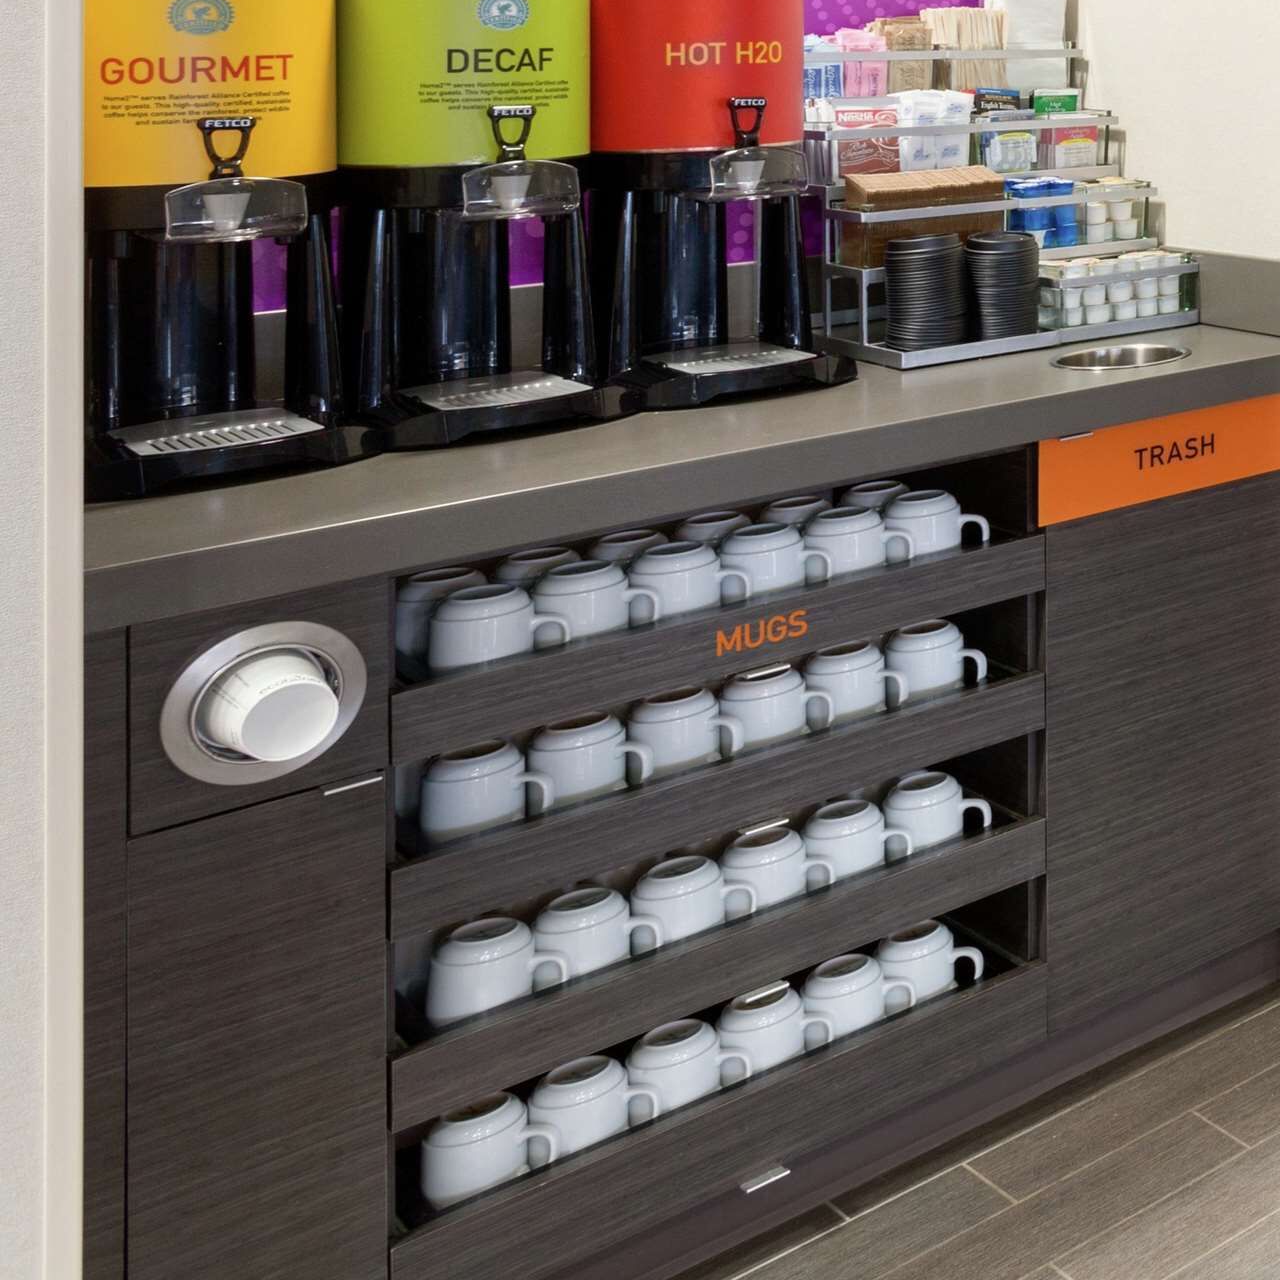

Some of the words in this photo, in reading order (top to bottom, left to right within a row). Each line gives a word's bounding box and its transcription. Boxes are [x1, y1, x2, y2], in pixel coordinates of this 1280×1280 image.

[446, 48, 555, 74] DECAF
[665, 42, 726, 66] HOT
[100, 53, 294, 86] GOURMET
[204, 119, 251, 128] FETCO
[493, 108, 533, 116] FETCO
[1133, 433, 1216, 471] TRASH
[715, 610, 809, 657] MUGS
